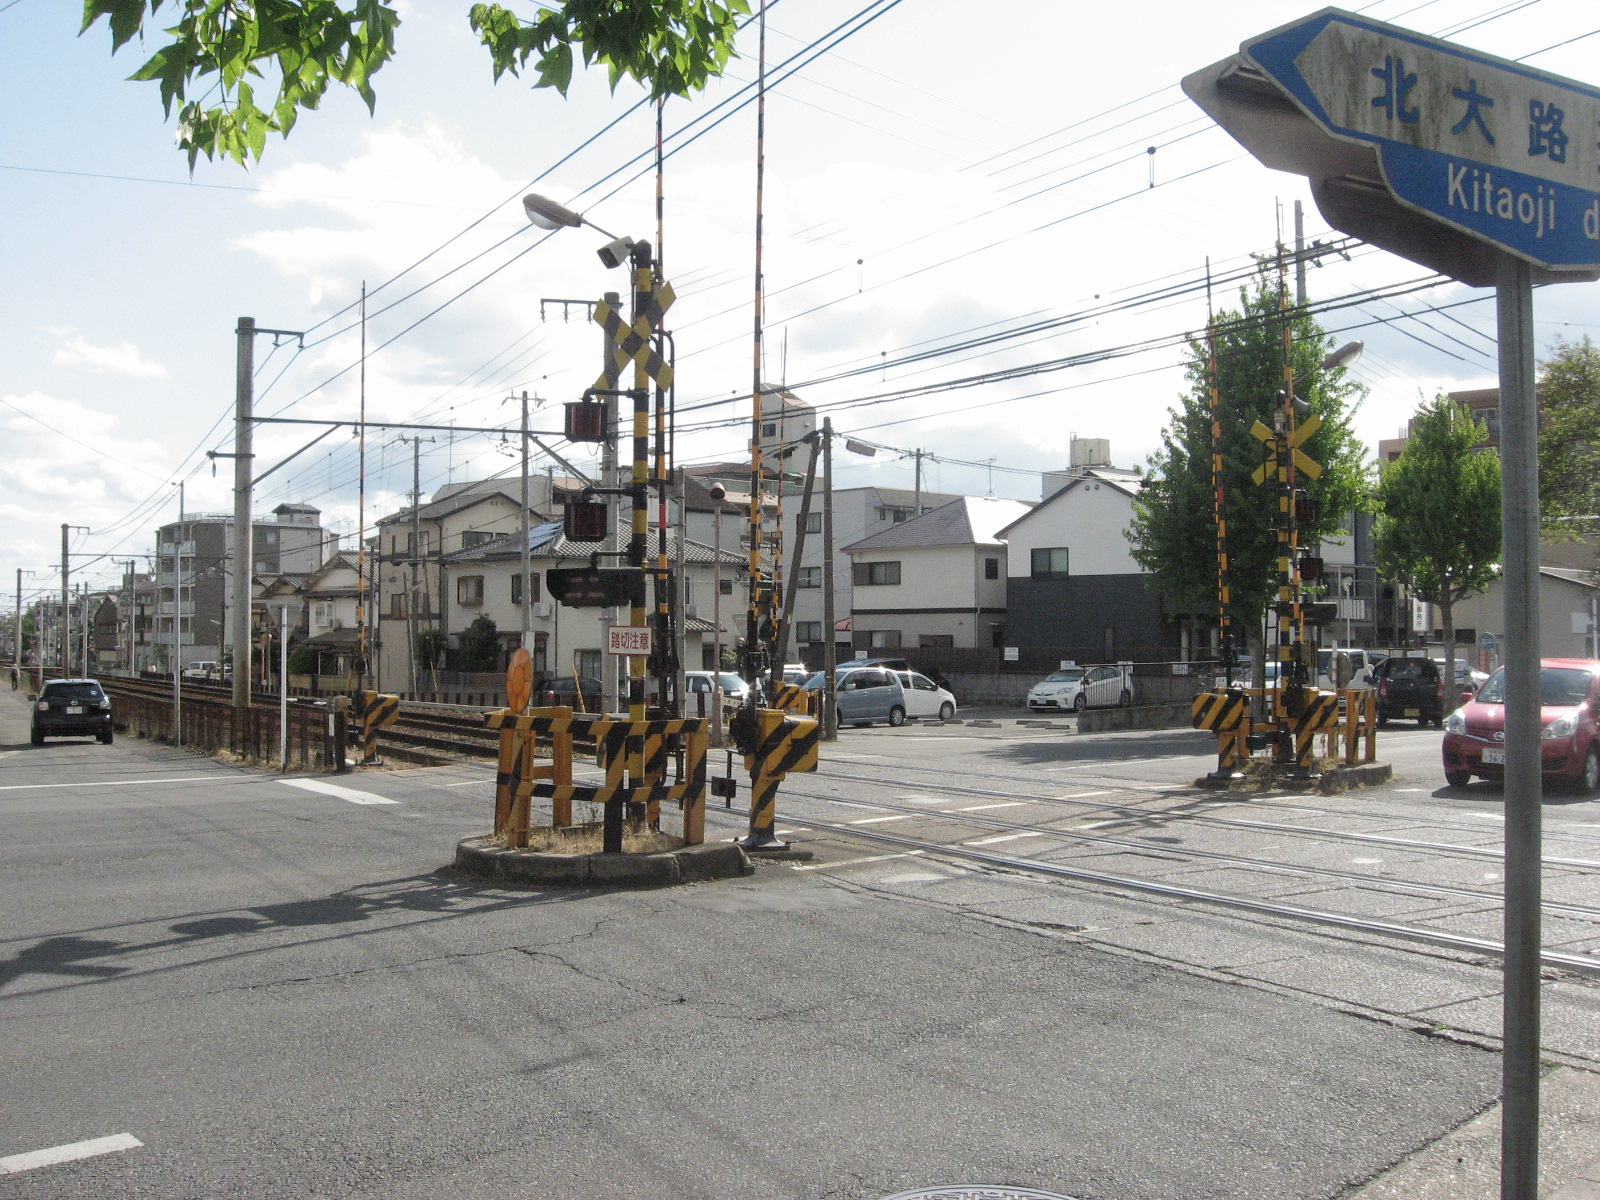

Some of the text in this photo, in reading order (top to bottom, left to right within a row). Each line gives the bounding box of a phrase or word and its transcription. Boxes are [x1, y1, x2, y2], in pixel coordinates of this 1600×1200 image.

[1371, 54, 1600, 173] 北大路
[1447, 162, 1556, 238] Kitaoji
[611, 632, 649, 649] 踏切注意
[1489, 754, 1505, 763] 36-2
